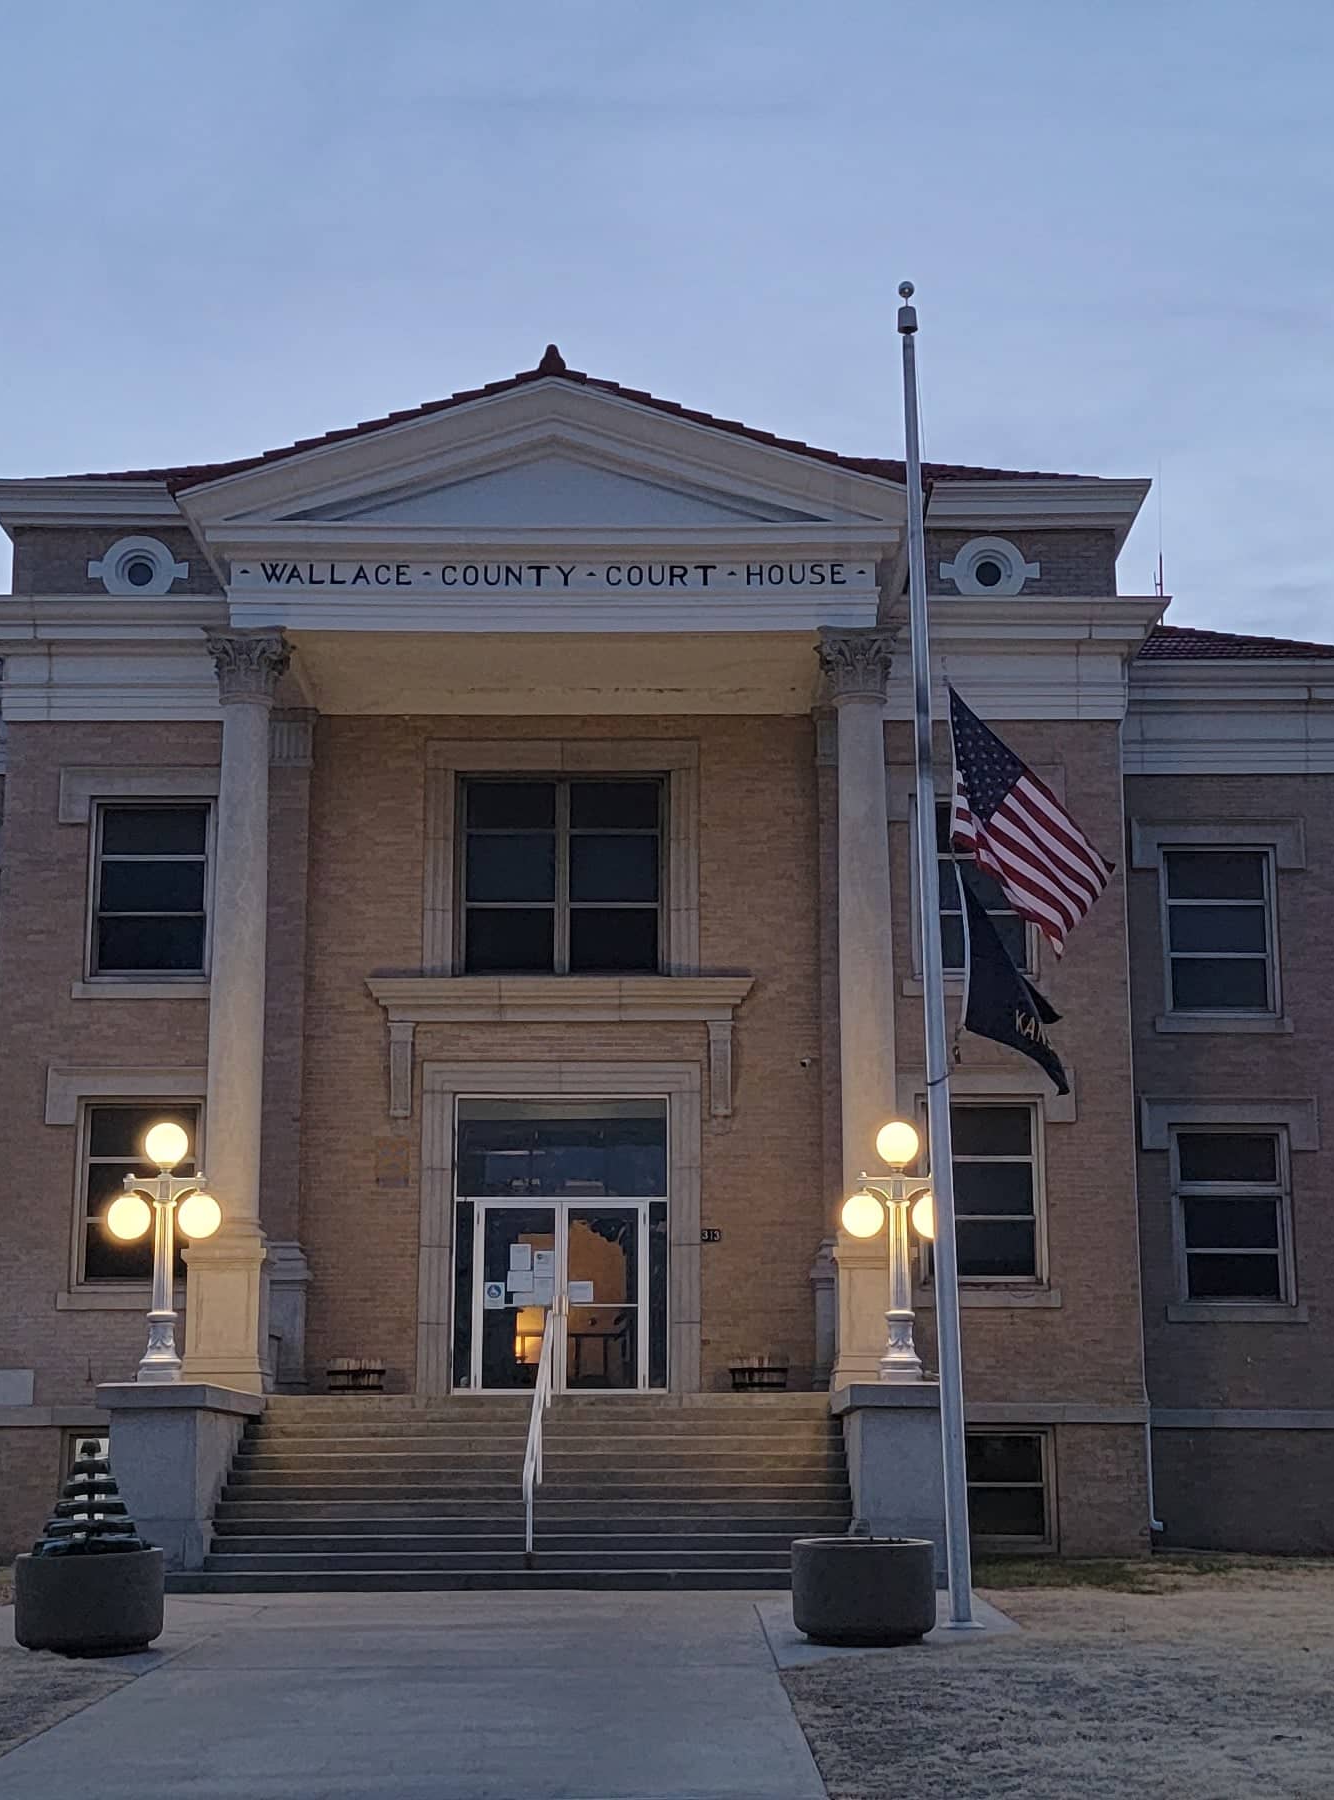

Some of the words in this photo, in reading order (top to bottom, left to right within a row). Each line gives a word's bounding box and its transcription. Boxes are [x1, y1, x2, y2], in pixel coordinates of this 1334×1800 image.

[260, 562, 413, 586] WALLACE
[441, 564, 577, 587] COUNTY
[605, 564, 717, 587] COURT
[745, 563, 847, 586] HOUSE
